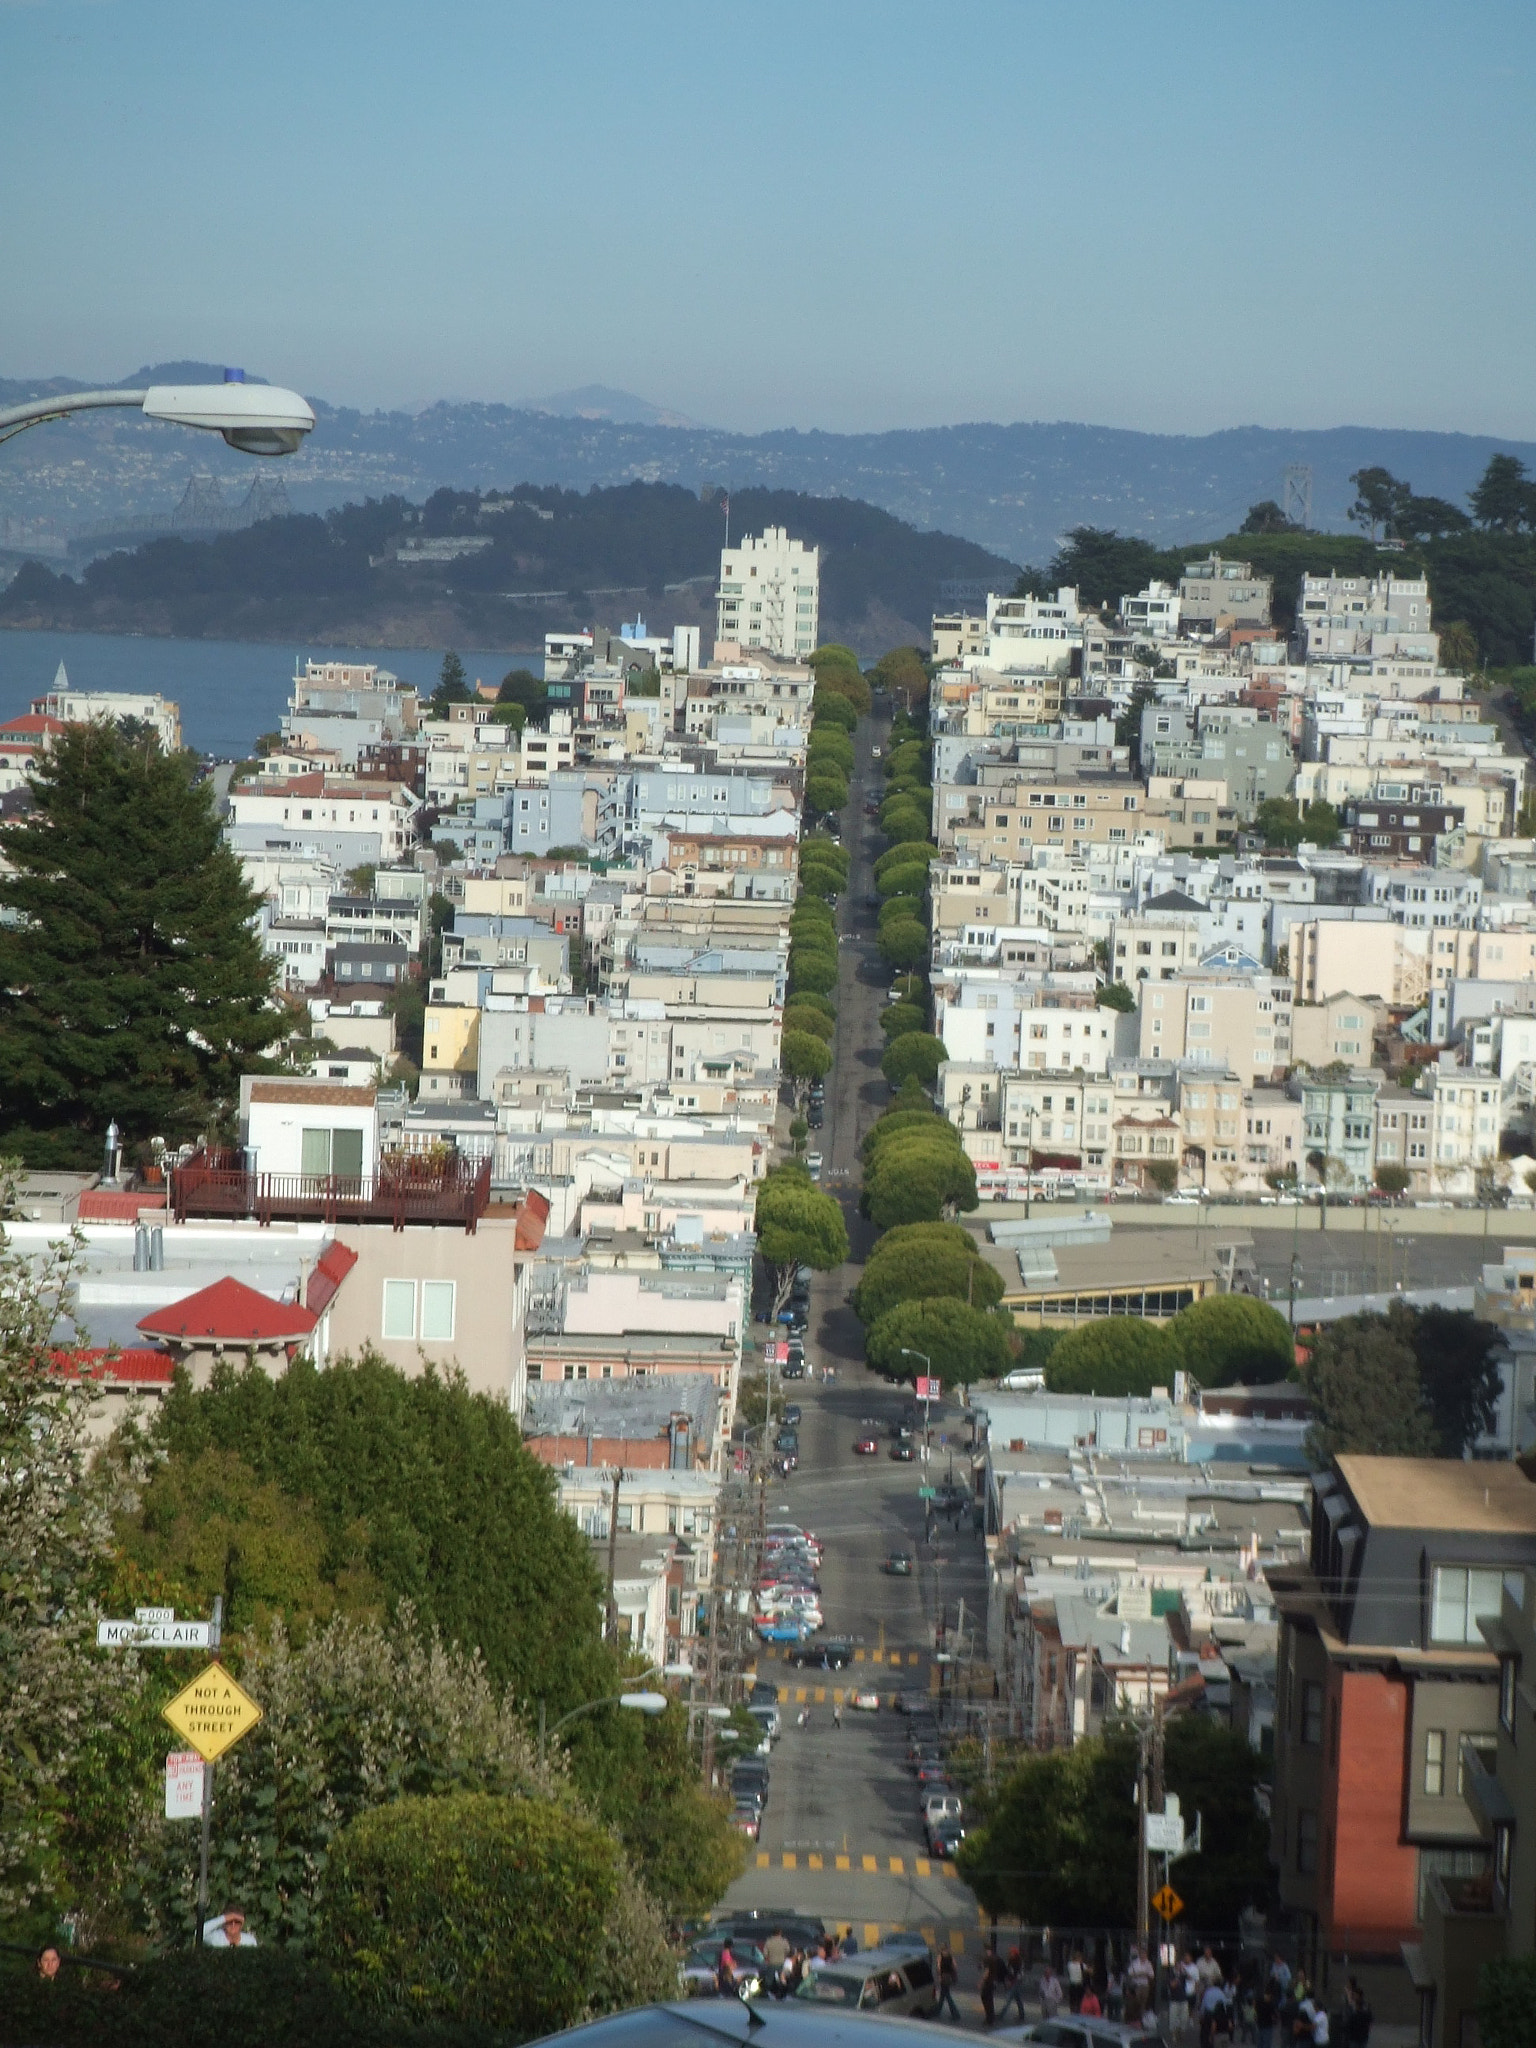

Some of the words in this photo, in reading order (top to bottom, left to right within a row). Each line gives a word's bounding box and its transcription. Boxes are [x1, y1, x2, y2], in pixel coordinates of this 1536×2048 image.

[195, 1688, 218, 1698] NOT
[223, 1688, 231, 1698] A
[184, 1704, 241, 1715] THROUGH
[188, 1721, 233, 1732] STREET
